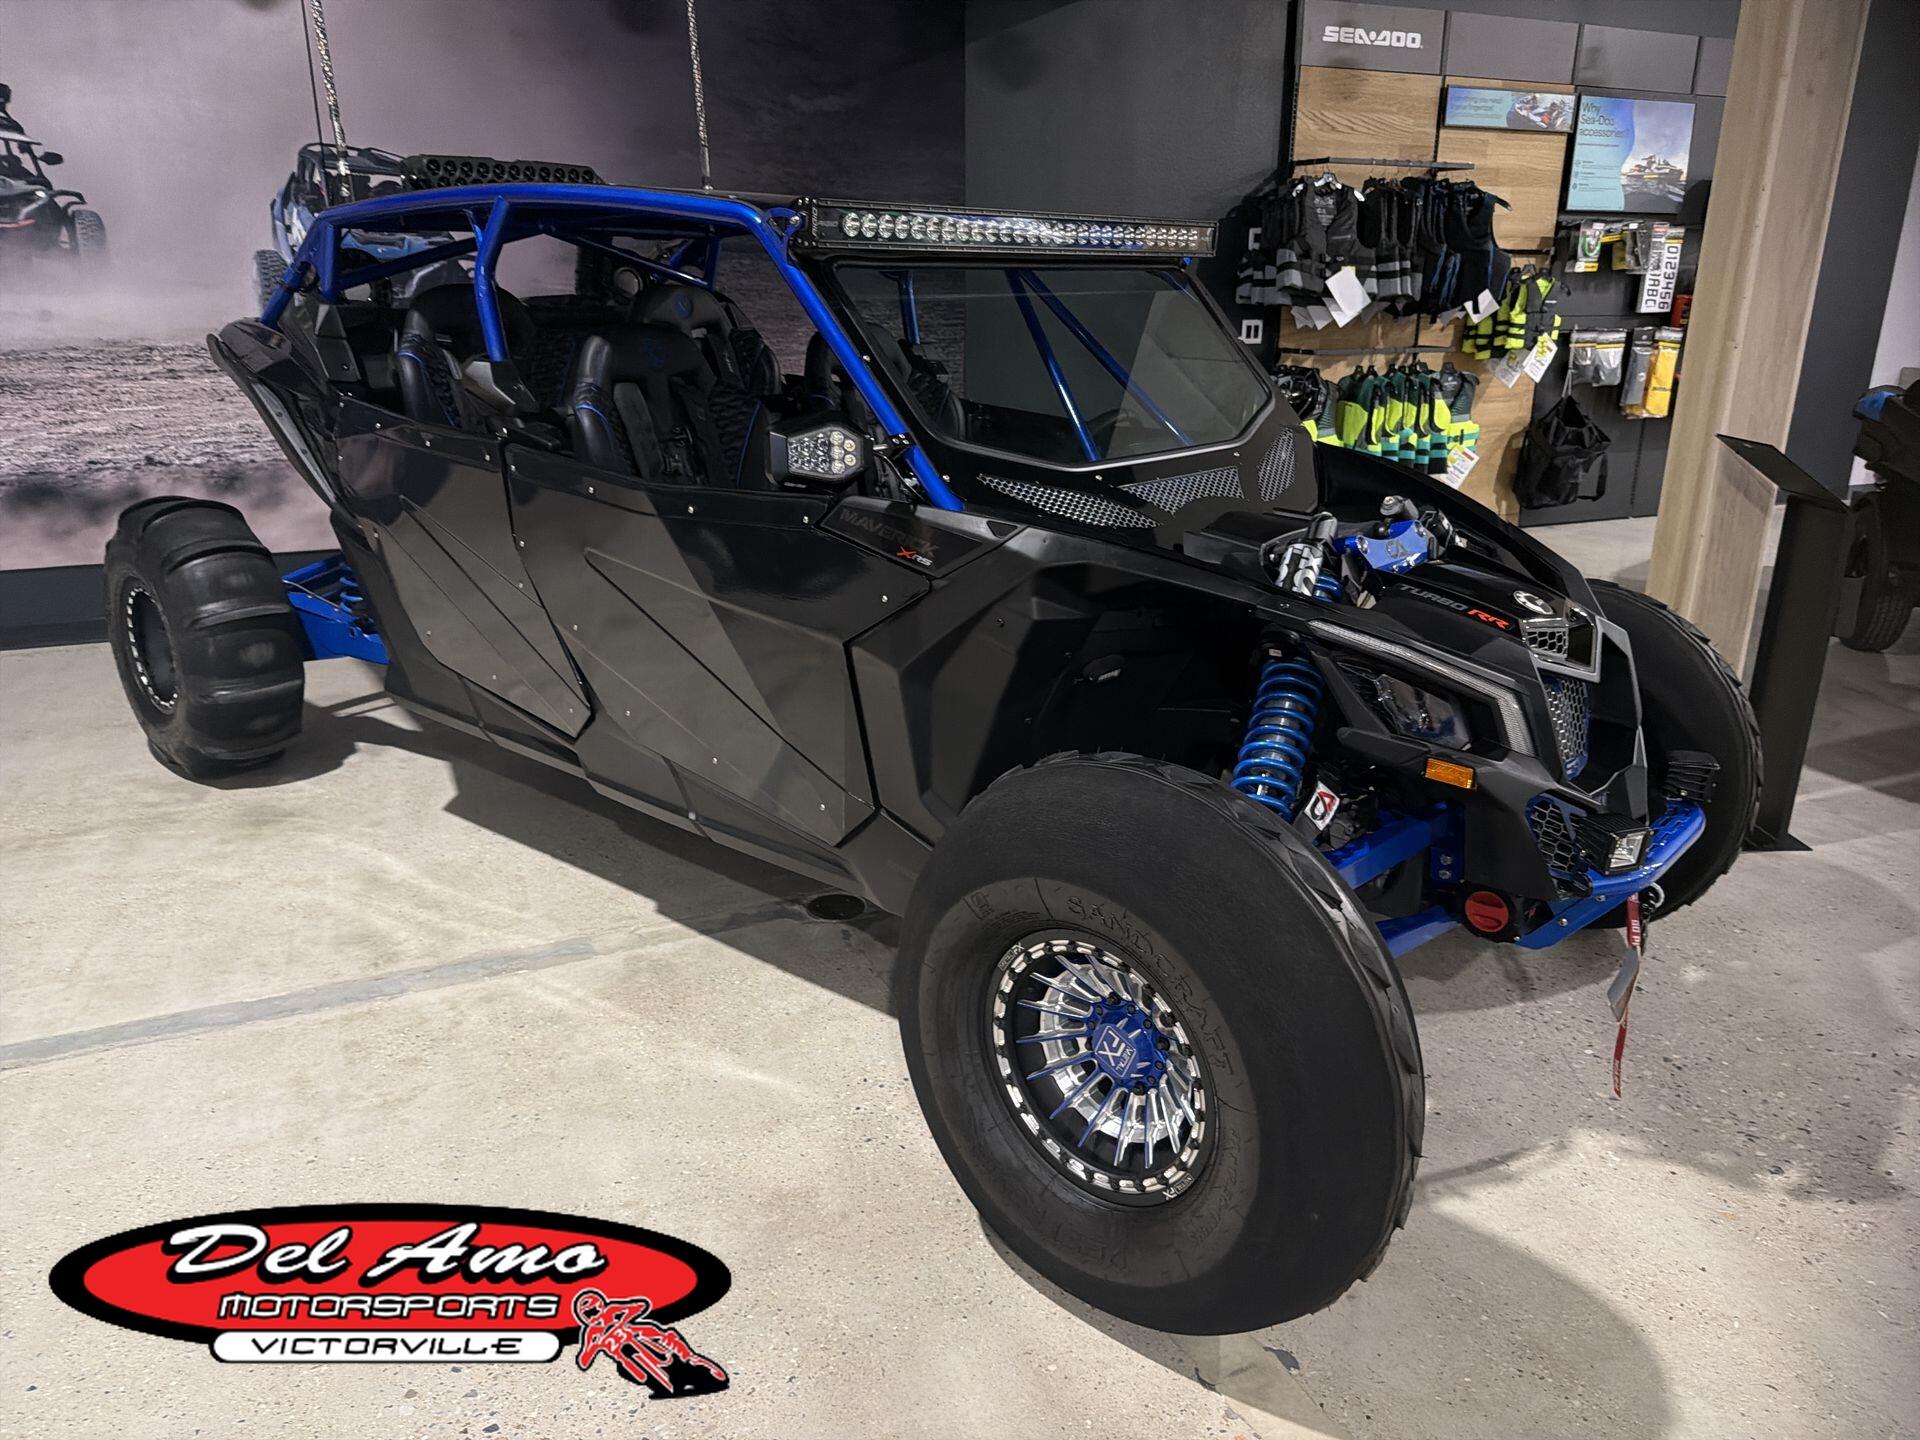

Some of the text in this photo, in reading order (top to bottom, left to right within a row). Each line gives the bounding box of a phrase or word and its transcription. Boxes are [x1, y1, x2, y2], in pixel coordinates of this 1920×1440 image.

[1582, 102, 1601, 115] Why
[1400, 583, 1469, 611] TURBO
[1466, 608, 1511, 630] RR
